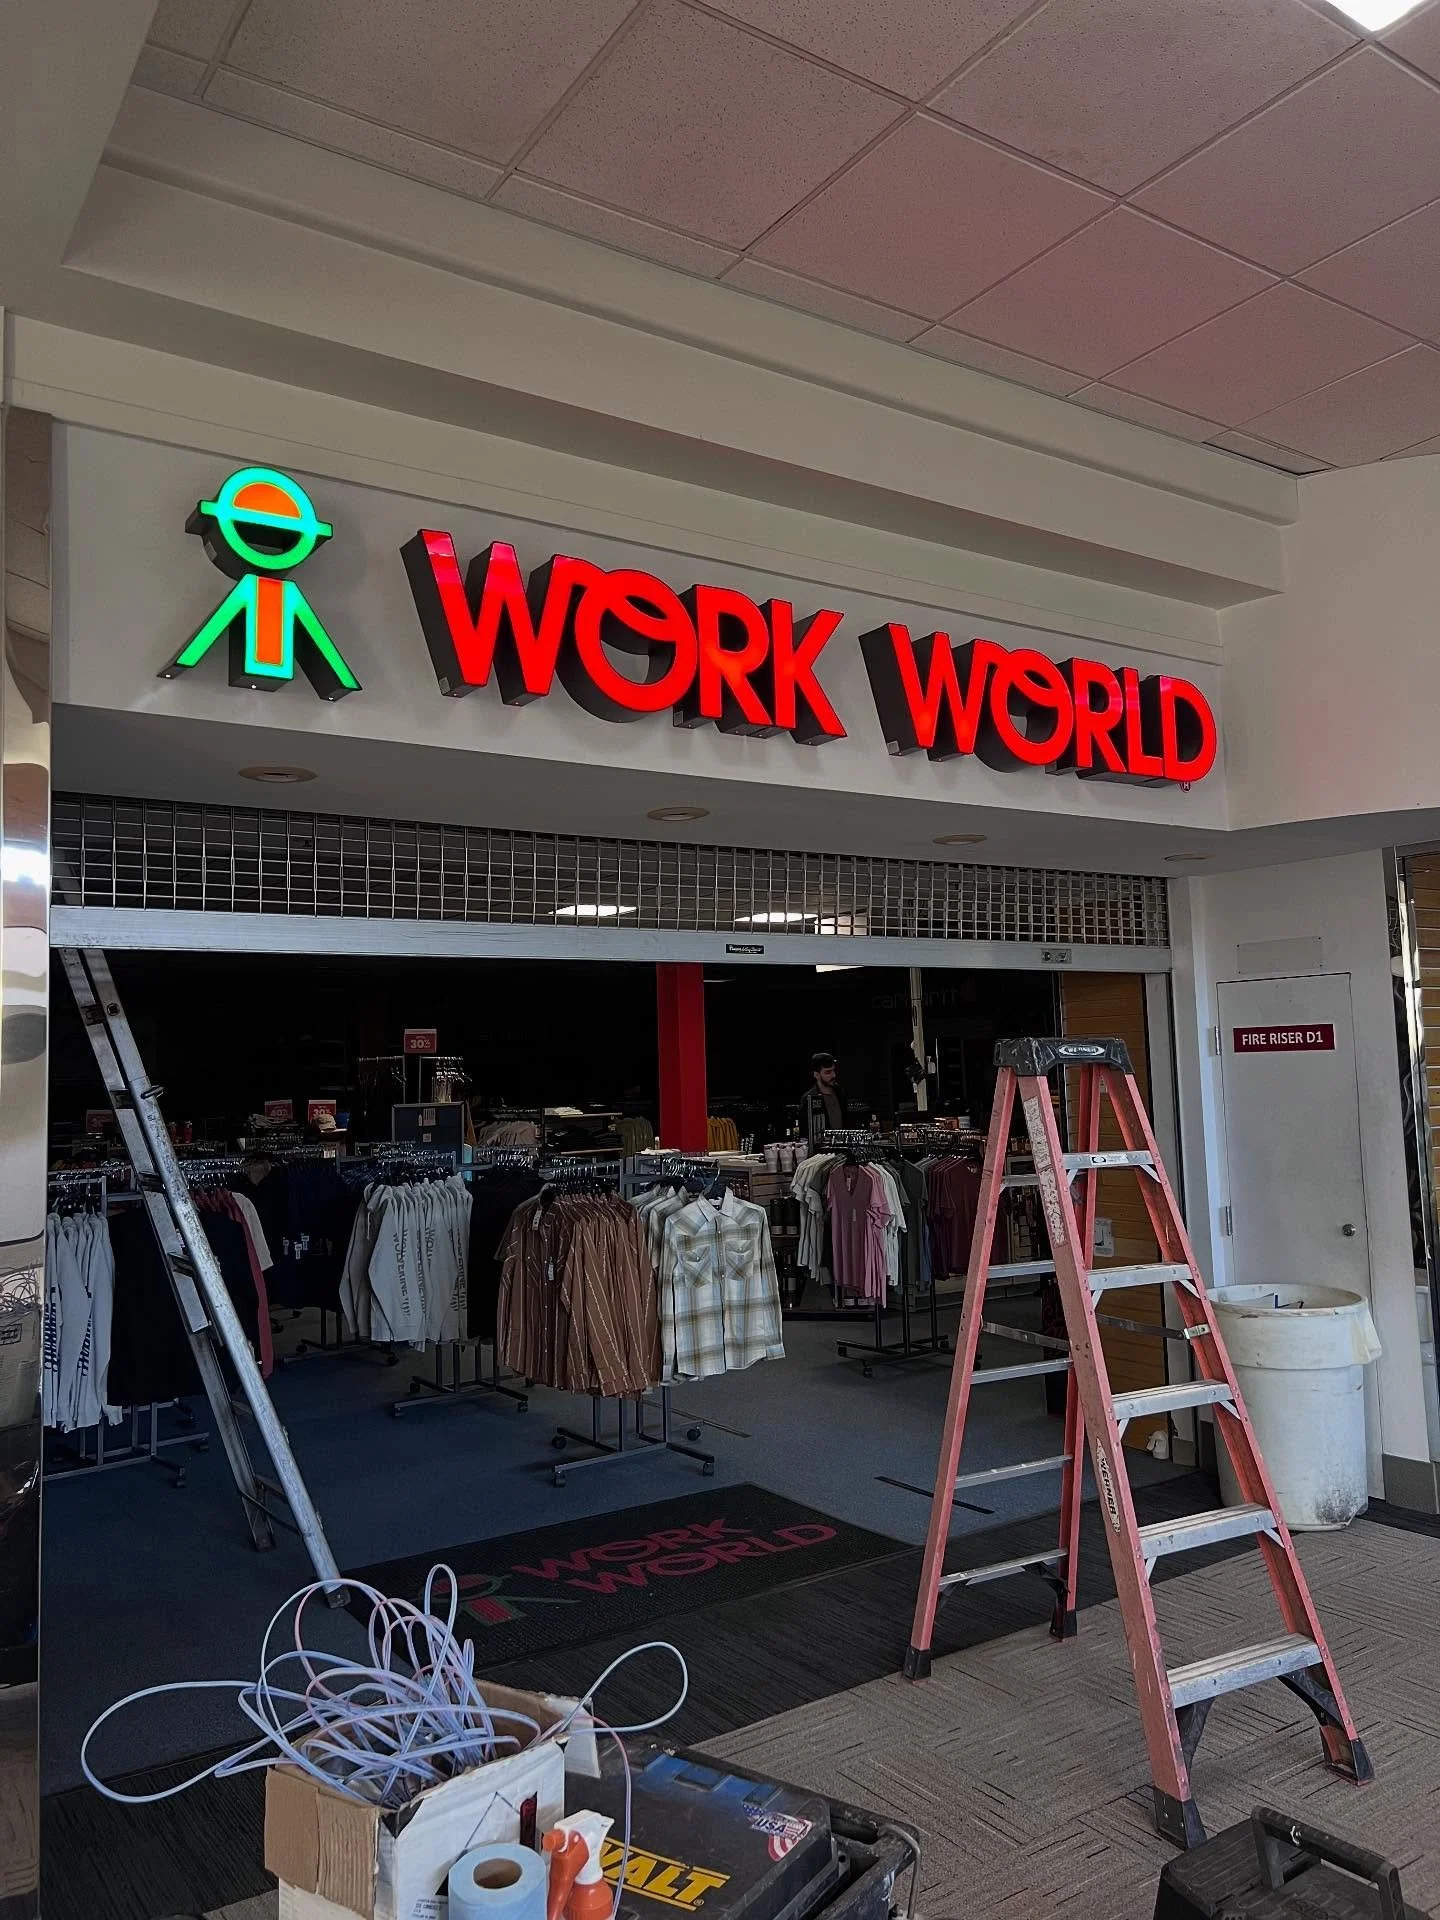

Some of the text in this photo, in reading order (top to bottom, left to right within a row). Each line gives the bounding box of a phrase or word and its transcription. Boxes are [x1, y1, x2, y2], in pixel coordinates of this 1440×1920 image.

[419, 529, 1217, 783] WORK WORLD
[1241, 1030, 1324, 1046] FIRE RISER D1
[1100, 1457, 1117, 1515] WERNER
[511, 1518, 752, 1581] WORK
[564, 1522, 838, 1595] WORLD
[755, 1818, 787, 1833] USA
